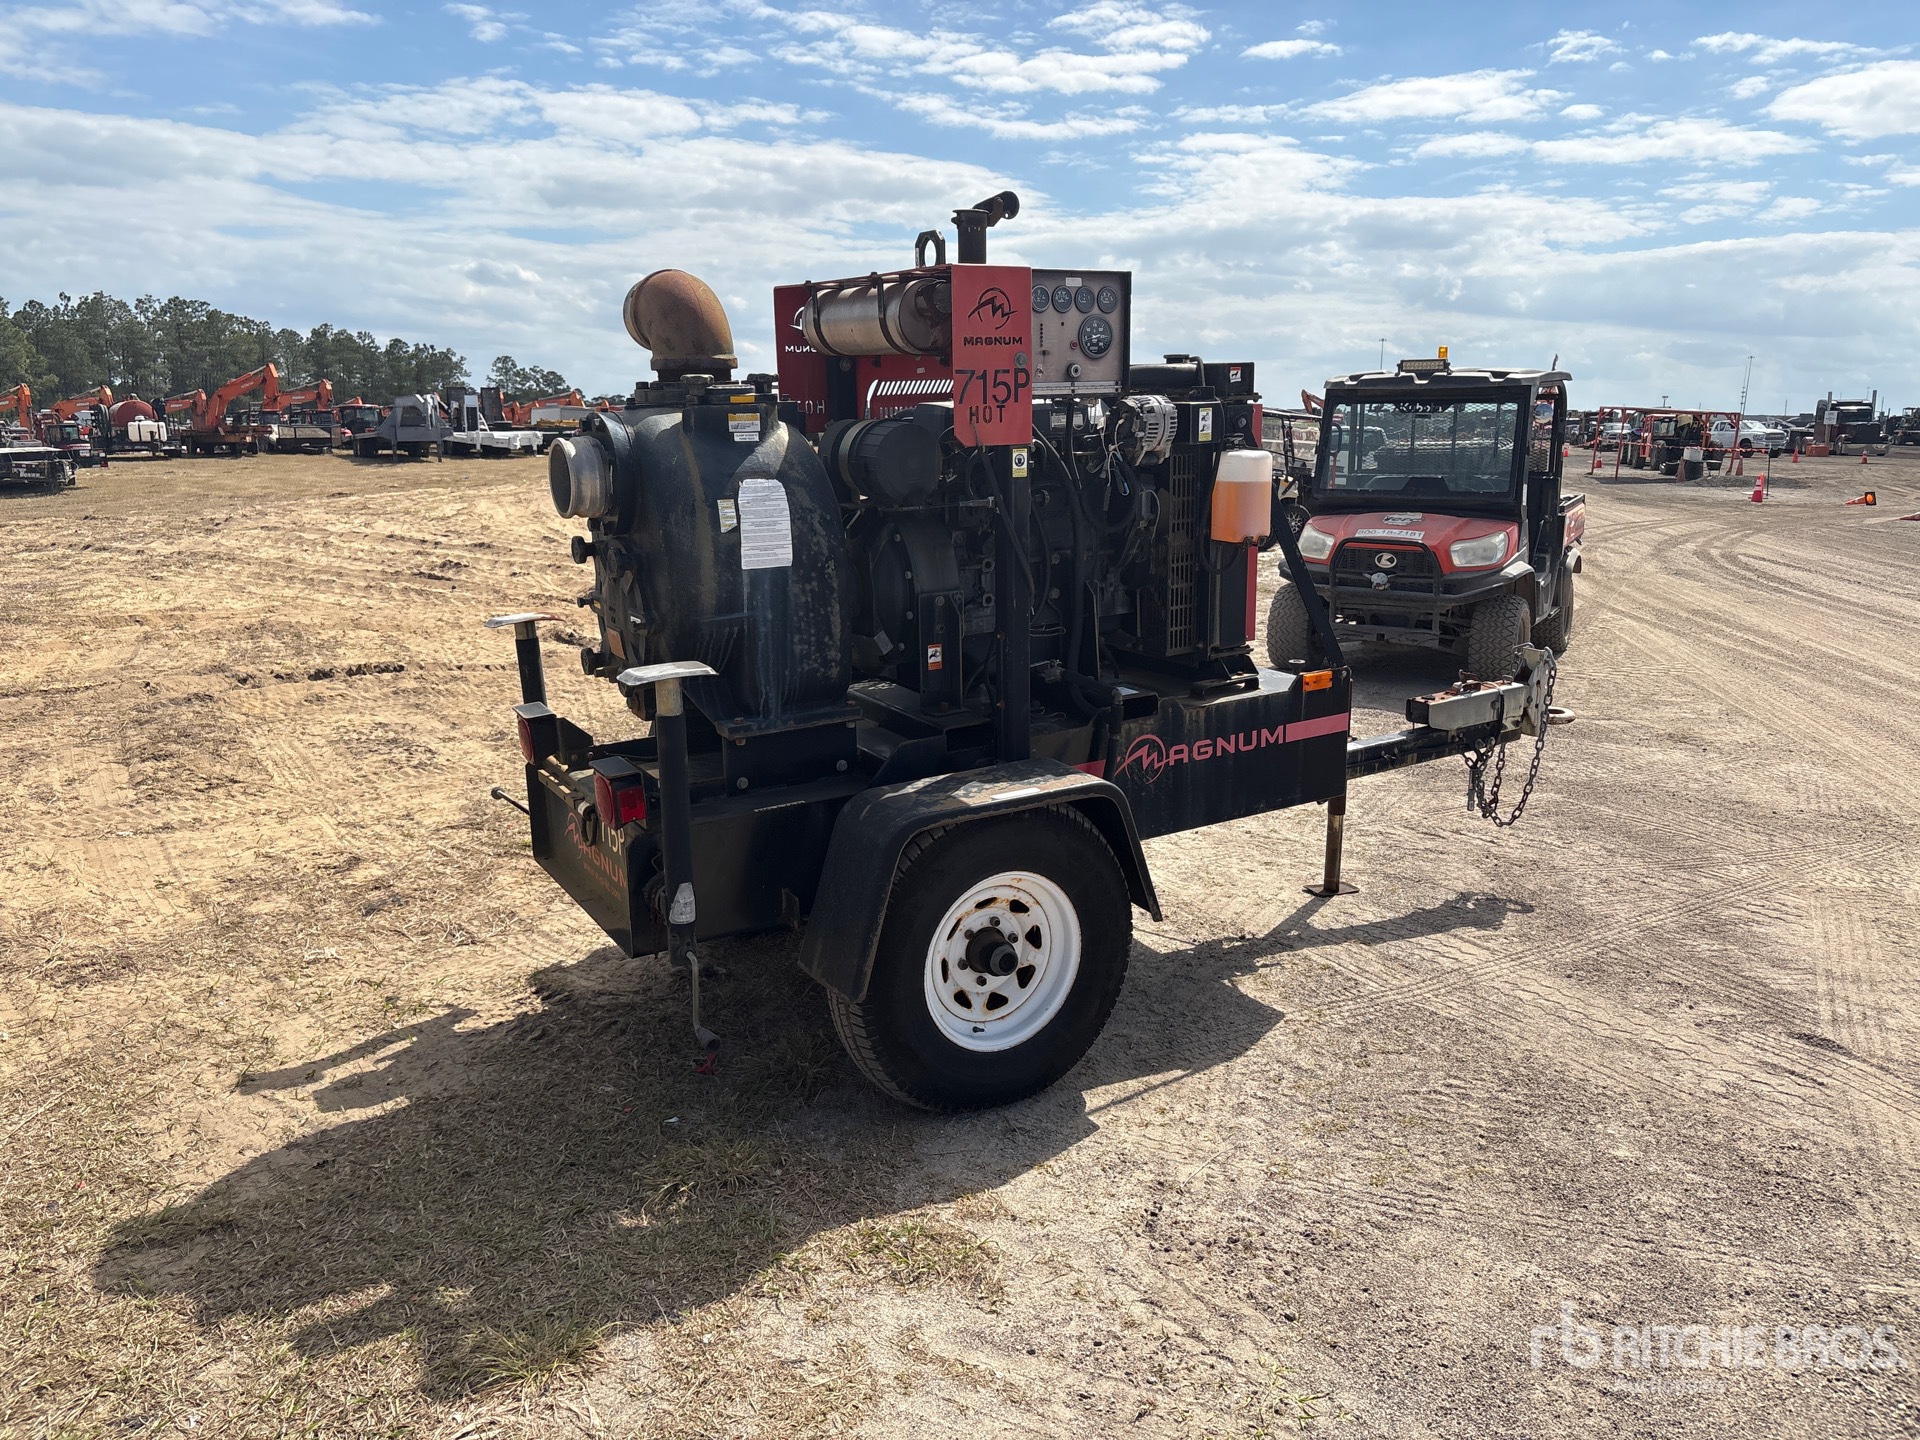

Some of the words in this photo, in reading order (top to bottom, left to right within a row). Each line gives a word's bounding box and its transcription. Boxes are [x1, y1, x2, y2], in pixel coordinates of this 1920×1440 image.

[963, 336, 1023, 347] MAGNUM
[955, 367, 1030, 405] 715P
[969, 405, 1006, 424] HOT
